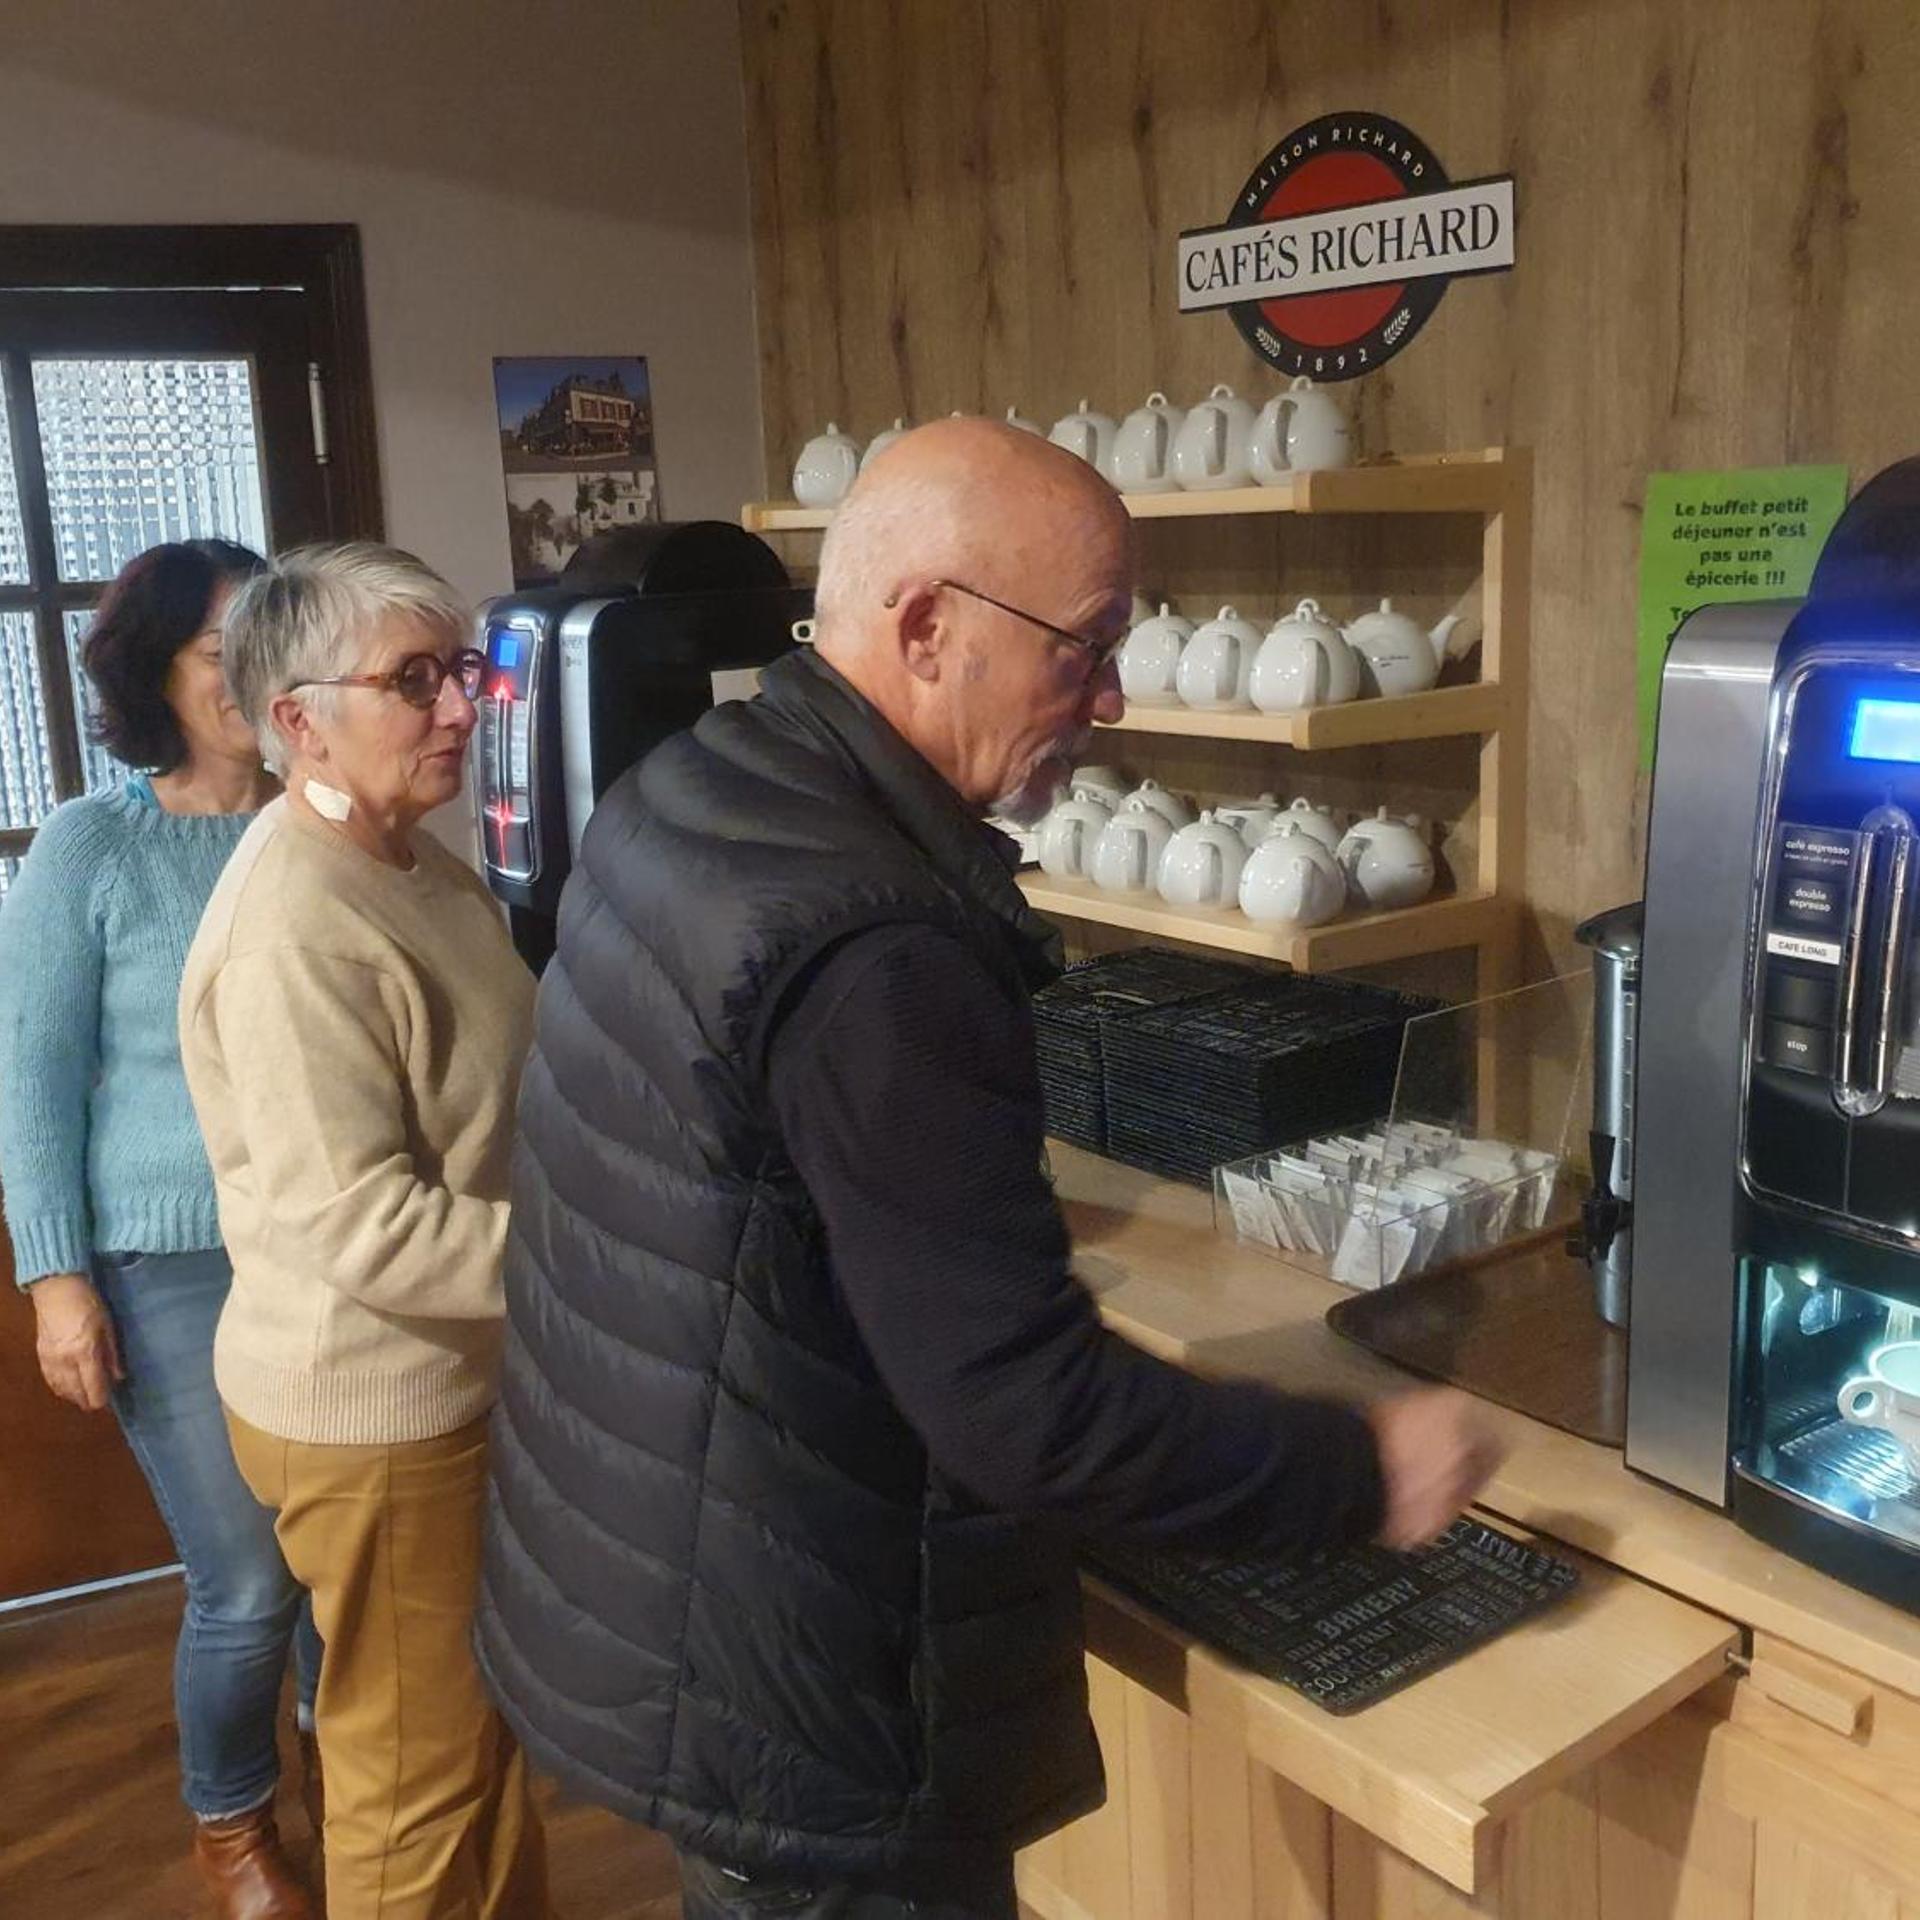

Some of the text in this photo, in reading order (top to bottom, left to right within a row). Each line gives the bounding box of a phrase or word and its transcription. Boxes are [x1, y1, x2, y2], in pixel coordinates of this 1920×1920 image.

[1247, 128, 1424, 207] MAISON RICHARD
[1185, 202, 1500, 292] CAFÉS RICHARD
[1296, 348, 1368, 371] 1892
[1675, 497, 1808, 517] Le buffet petit
[1672, 523, 1753, 542] déjeuner
[1700, 549, 1773, 565] pas une
[1685, 570, 1785, 588] épicerie !!!
[1795, 888, 1827, 900] double
[1314, 1577, 1421, 1640] BAKERY
